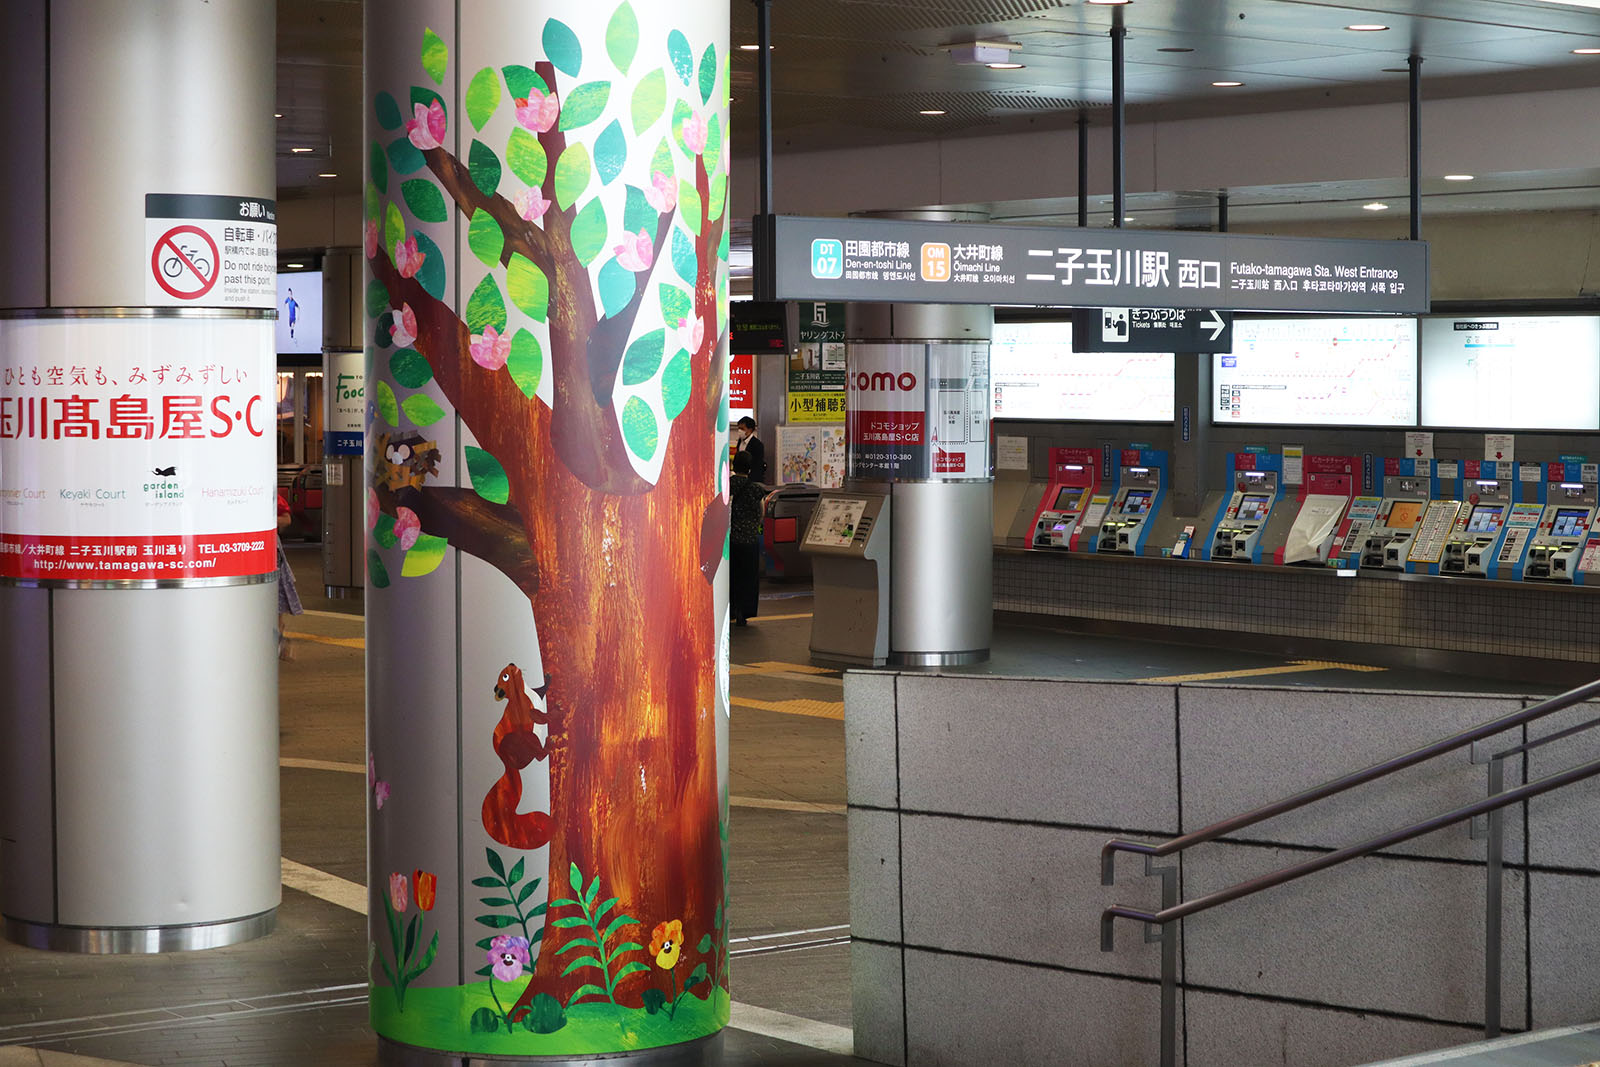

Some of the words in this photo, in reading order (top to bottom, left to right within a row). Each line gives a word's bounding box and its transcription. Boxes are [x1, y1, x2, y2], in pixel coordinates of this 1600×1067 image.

[240, 202, 265, 217] お願い
[820, 244, 835, 255] DT
[845, 240, 910, 257] 田園都市線
[927, 247, 944, 259] OM
[953, 244, 1003, 261] 大井町線
[224, 260, 236, 270] Do
[239, 262, 251, 270] not
[252, 262, 263, 272] ride
[817, 257, 837, 273] 07
[845, 259, 893, 270] Den-en-toshi
[895, 260, 912, 270] Line
[927, 260, 946, 277] 15
[985, 263, 1000, 273] Line
[1026, 248, 1170, 288] 二子玉川駅
[1178, 259, 1221, 289] 西口
[1230, 262, 1312, 279] Futako-tamagawa
[1314, 265, 1333, 277] Sta.
[1335, 266, 1358, 278] West
[1359, 266, 1399, 279] Entrance
[224, 275, 242, 285] past
[244, 275, 257, 284] this
[1273, 280, 1298, 291] 西入口
[1389, 282, 1405, 294] 입구
[4, 365, 248, 386] ひとも空気も、みずみずしい
[730, 367, 751, 375] adies
[870, 422, 920, 431] ドコモショップ
[869, 453, 912, 461] 0120-310-380
[143, 480, 179, 492] garden
[23, 488, 46, 499] Court
[60, 489, 91, 501] Keyaki
[95, 489, 126, 500] Court
[155, 489, 184, 498] island
[201, 487, 246, 498] Hanamizuki
[70, 545, 137, 556] 二子玉川駅前
[142, 544, 187, 556] 玉川通り
[198, 540, 265, 554] TEL.03-3709-2222
[34, 557, 217, 572] http://www.tamagawa-sc.com/
